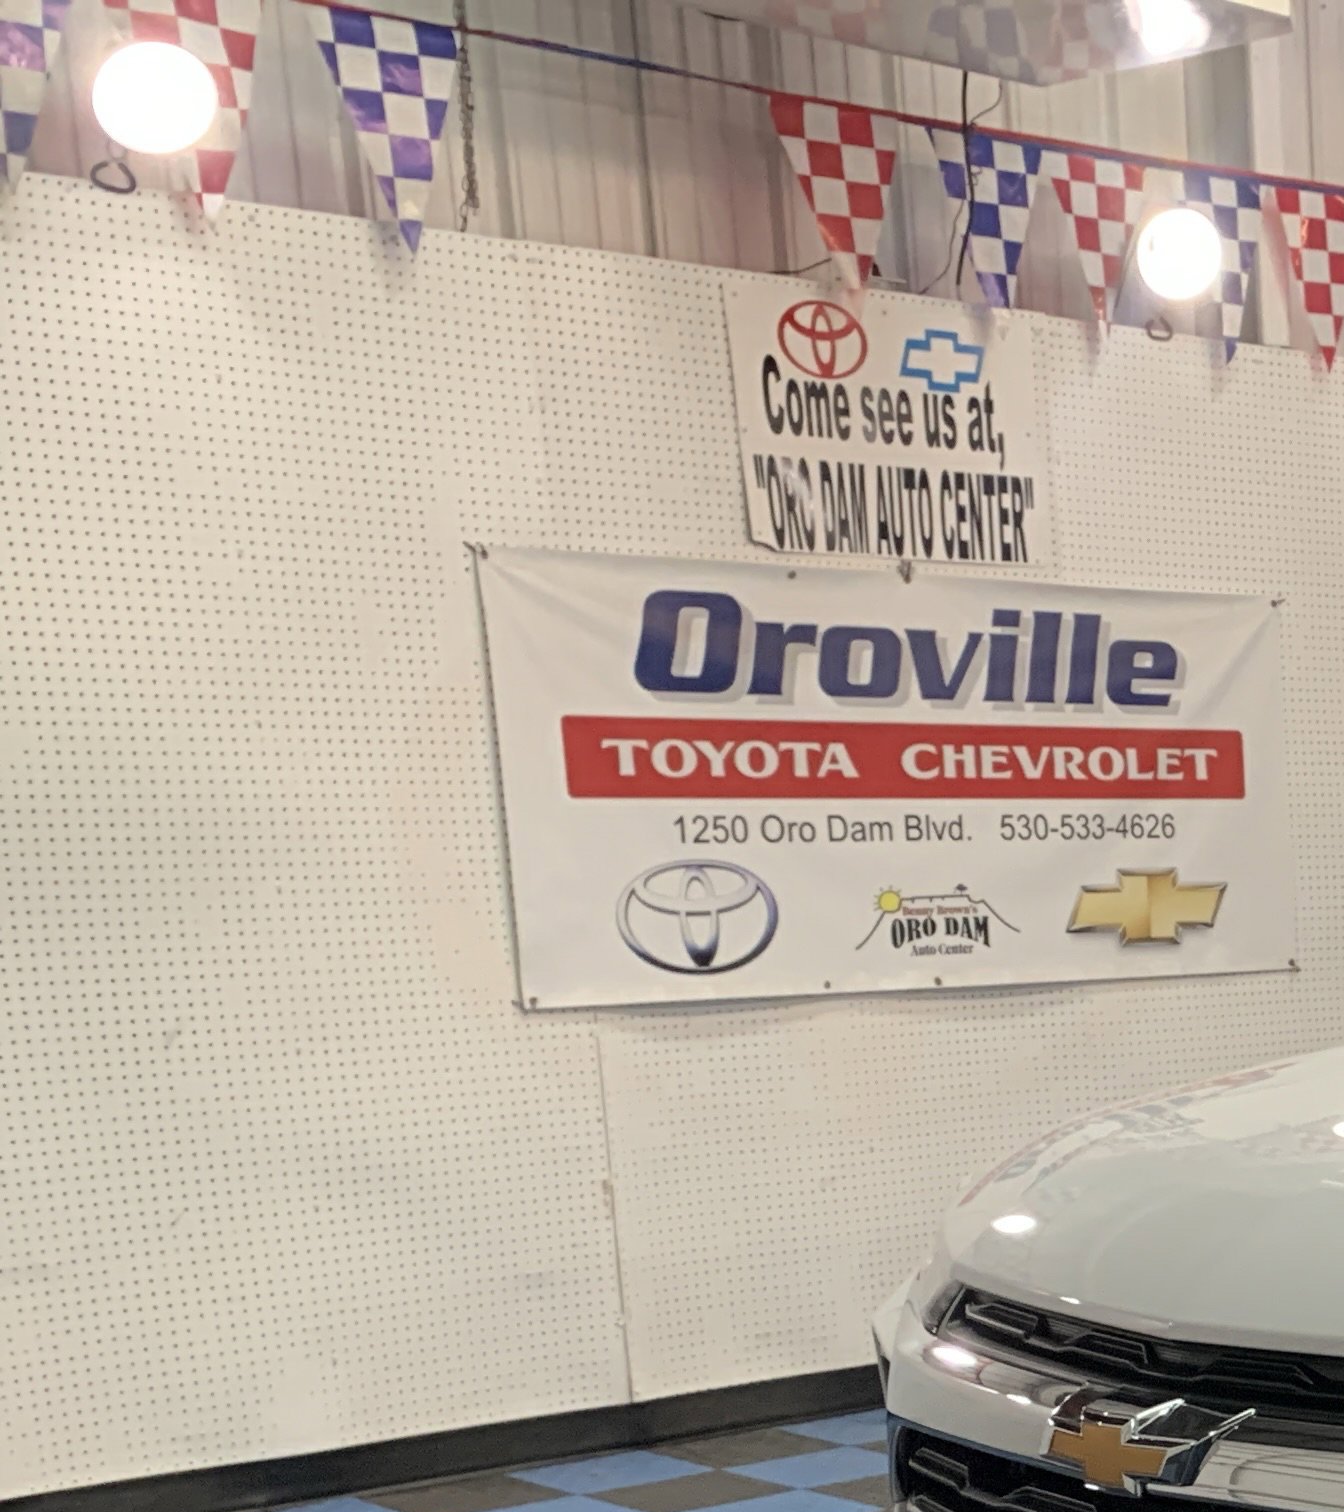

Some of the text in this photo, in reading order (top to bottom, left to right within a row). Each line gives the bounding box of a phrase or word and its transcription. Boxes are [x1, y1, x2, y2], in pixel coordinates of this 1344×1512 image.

[762, 354, 1005, 470] Come see us at,
[819, 460, 870, 554] DAM
[877, 465, 934, 559] AUTO
[940, 469, 1034, 563] CENTER"
[634, 589, 1180, 708] Oroville
[601, 738, 1218, 781] TOYOTA CHEVROLET
[673, 812, 1177, 845] 1250 Oro Dam Blvd. 530-533-4626
[891, 916, 991, 948] ORO DAM
[911, 943, 974, 957] Auto Center
